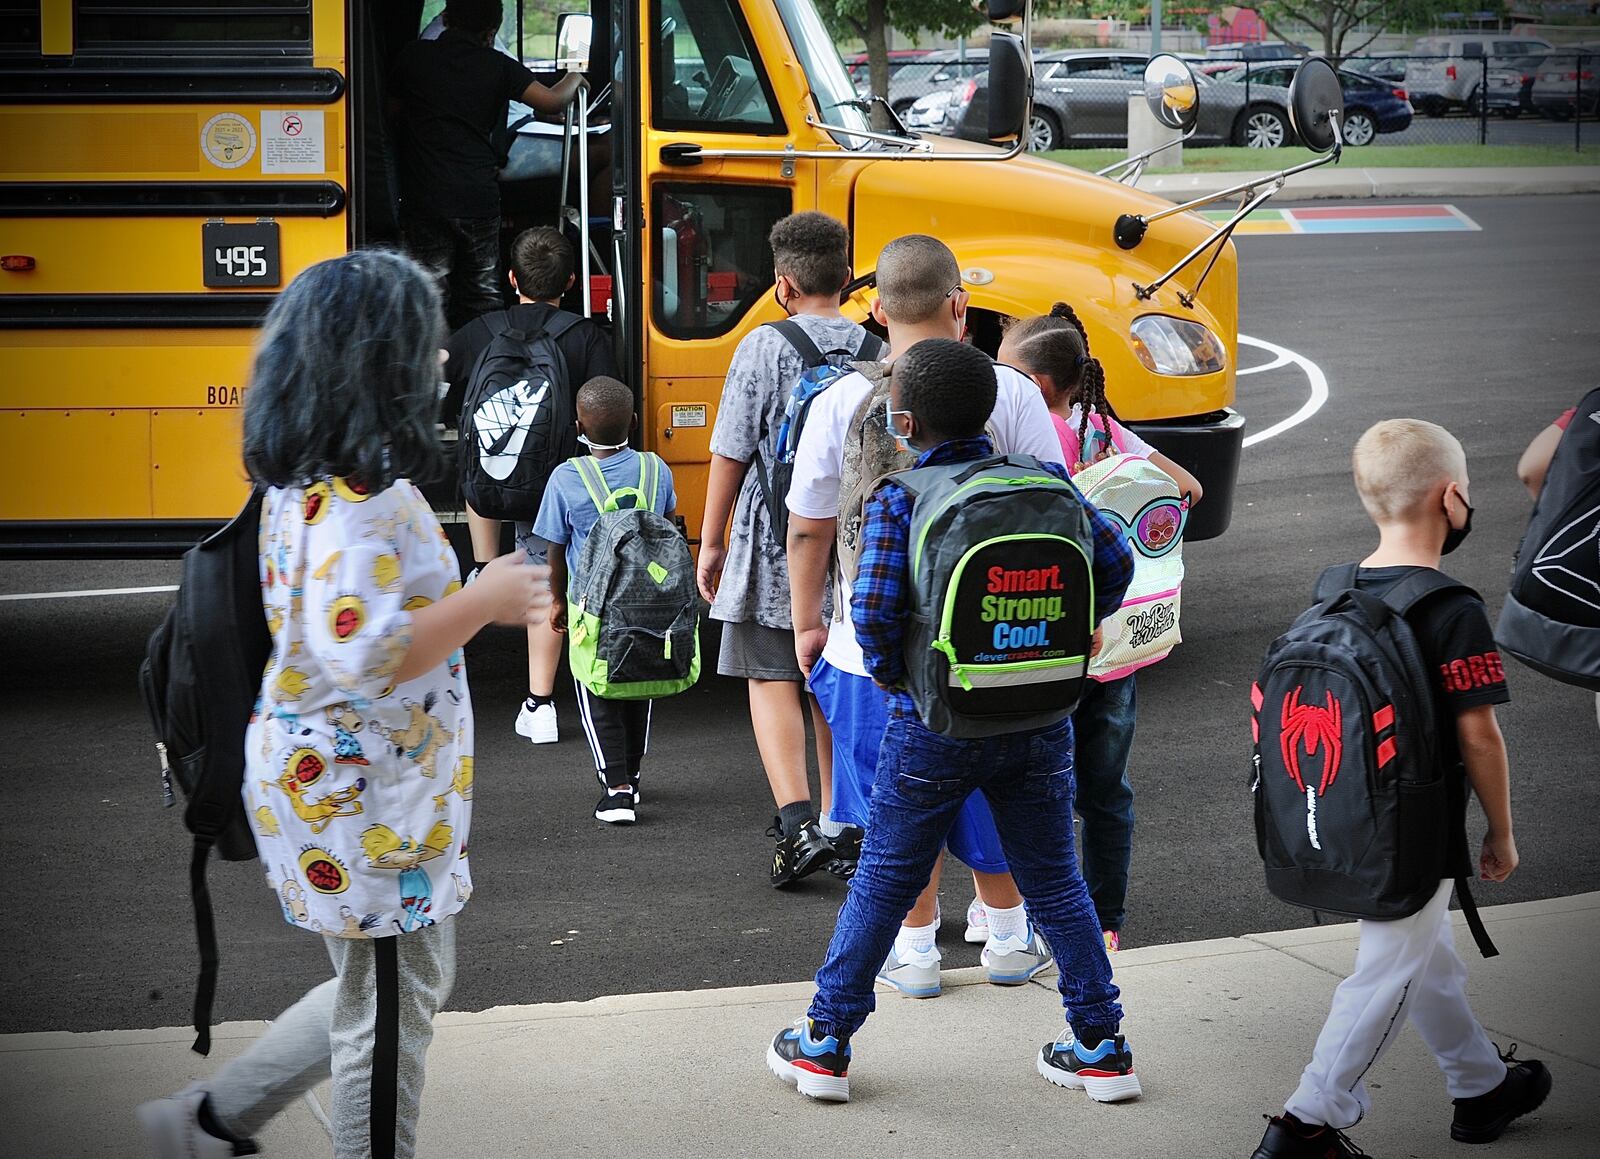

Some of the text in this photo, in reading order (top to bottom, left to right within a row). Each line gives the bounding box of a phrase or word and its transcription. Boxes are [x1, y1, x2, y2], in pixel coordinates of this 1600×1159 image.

[215, 246, 267, 276] 495
[987, 565, 1065, 593] Smart.
[981, 594, 1067, 622] Strong.
[993, 620, 1050, 650] Cool.
[973, 649, 1066, 662] clevercrazes.com
